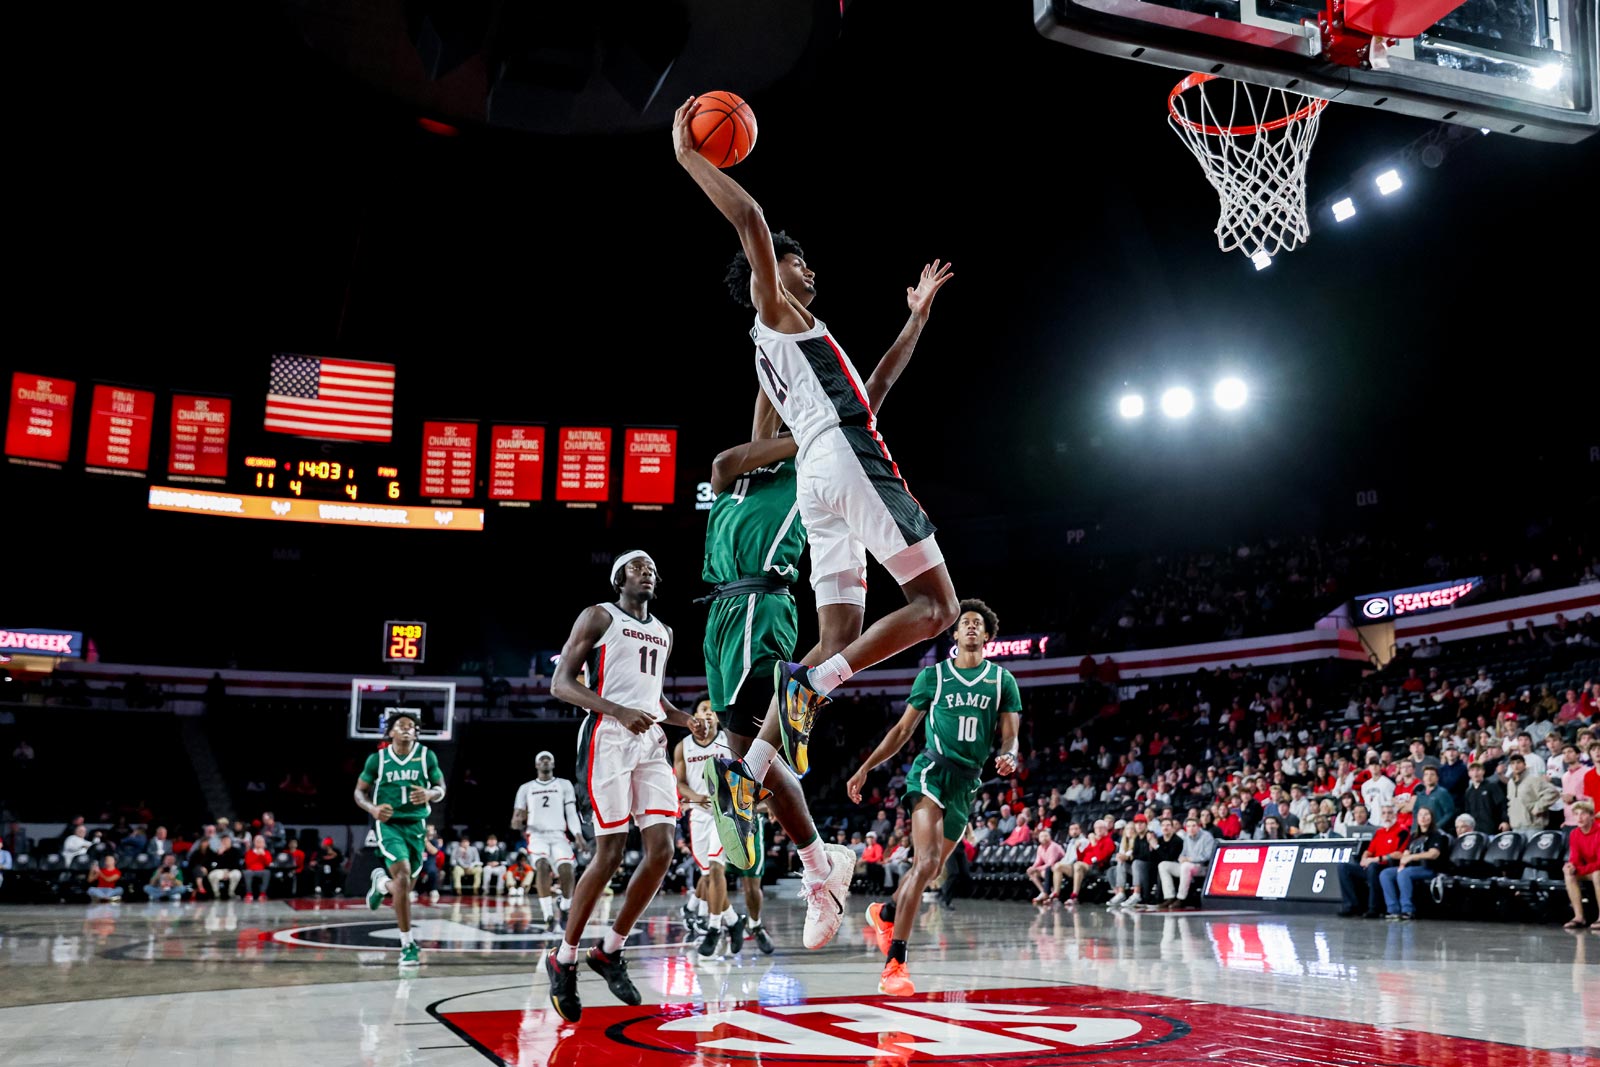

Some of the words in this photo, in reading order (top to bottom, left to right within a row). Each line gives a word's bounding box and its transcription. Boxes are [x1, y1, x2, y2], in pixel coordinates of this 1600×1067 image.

[18, 387, 68, 406] CHAMPIONS
[112, 401, 134, 414] FOUR
[177, 409, 225, 423] CHAMPIONS
[444, 426, 458, 437] SEC
[511, 429, 525, 439] SEC
[567, 431, 602, 441] NATIONAL
[634, 432, 667, 443] NATIONAL
[428, 436, 471, 447] CHAMPIONS
[496, 438, 539, 450] CHAMPIONS
[564, 441, 606, 451] CHAMPIONS
[629, 442, 671, 453] CHAMPIONS
[299, 461, 341, 479] 14:03
[256, 472, 274, 488] 11
[290, 480, 302, 496] 4
[346, 484, 357, 500] 4
[388, 481, 400, 498] 6
[696, 482, 717, 501] 3
[392, 625, 422, 639] 14:03
[622, 628, 668, 648] GEORGIA
[390, 636, 417, 658] 26
[639, 646, 658, 676] 11
[945, 692, 991, 709] FAMU
[957, 716, 978, 742] 10
[385, 769, 420, 783] FAMU
[401, 786, 407, 804] 1
[542, 795, 550, 808] 2
[1226, 869, 1243, 892] 11
[1312, 869, 1327, 893] 6
